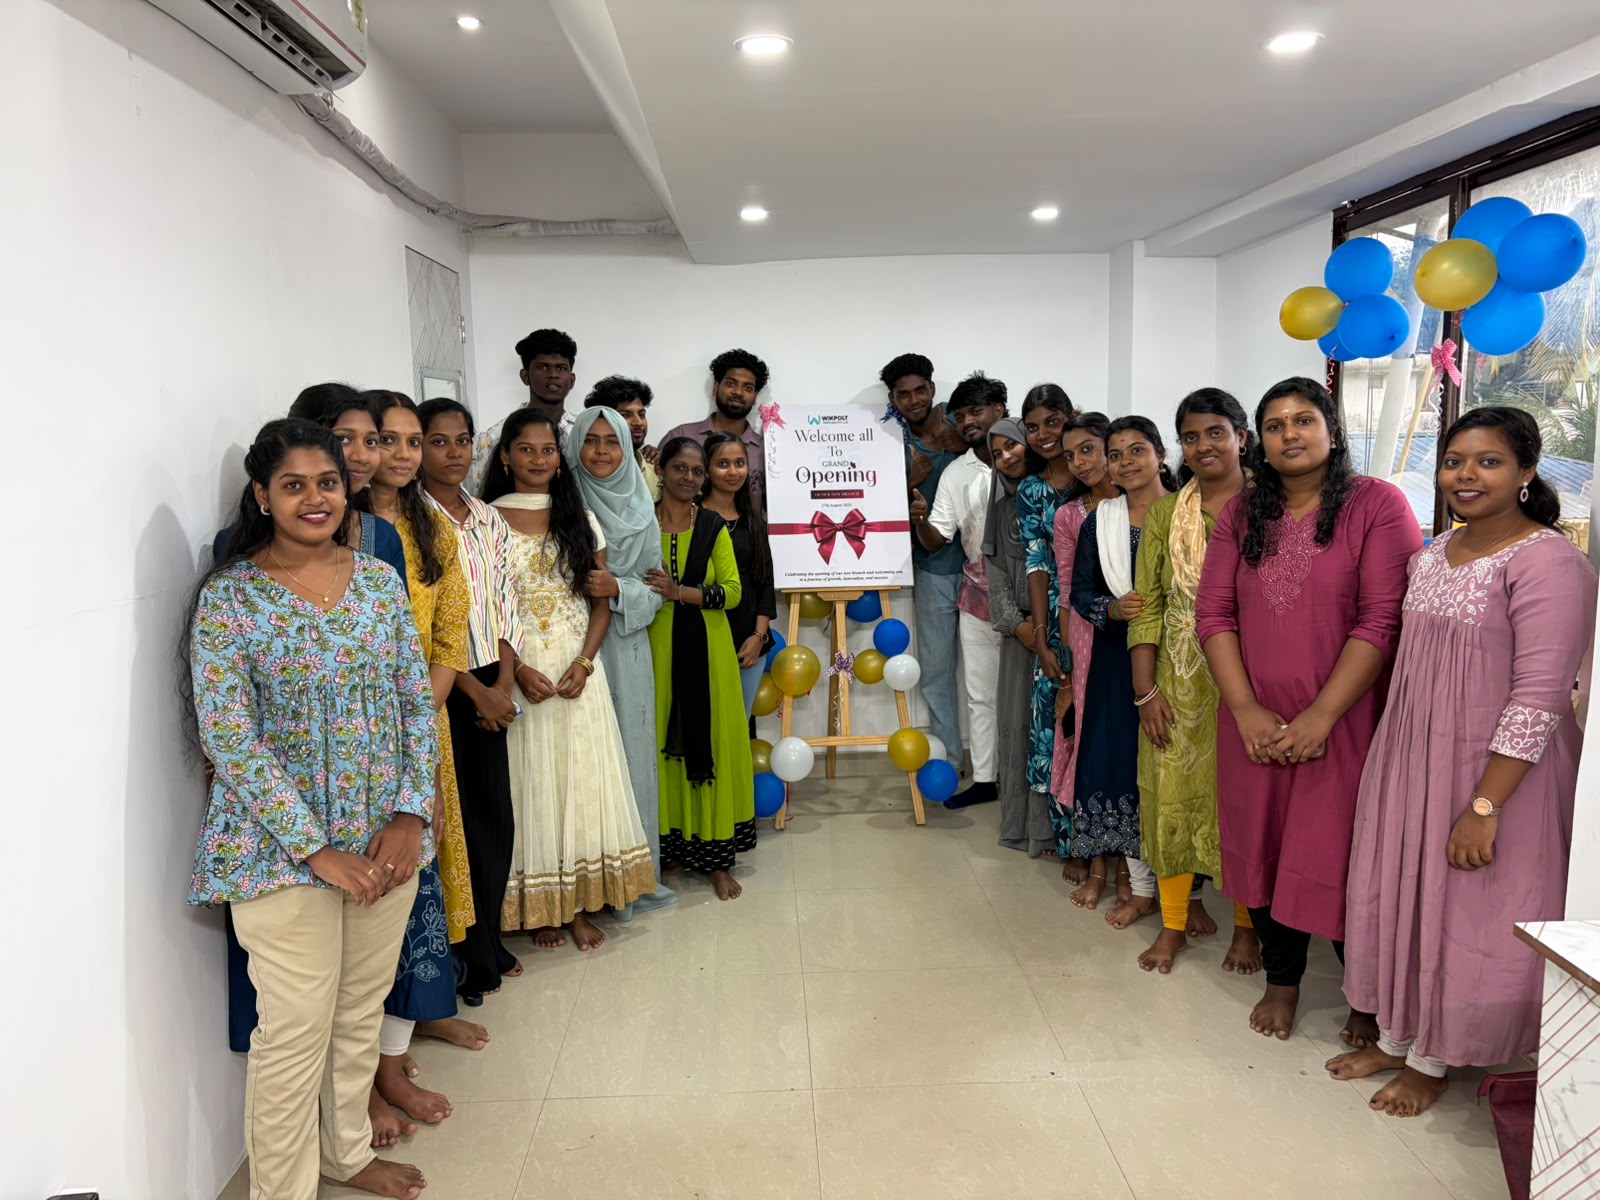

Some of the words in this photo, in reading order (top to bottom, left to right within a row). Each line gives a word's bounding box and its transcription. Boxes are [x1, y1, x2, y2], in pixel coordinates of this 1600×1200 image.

[795, 429, 855, 442] Welcome
[860, 428, 874, 441] all
[827, 445, 843, 457] To
[822, 460, 849, 468] GRAND
[796, 466, 877, 489] Opening
